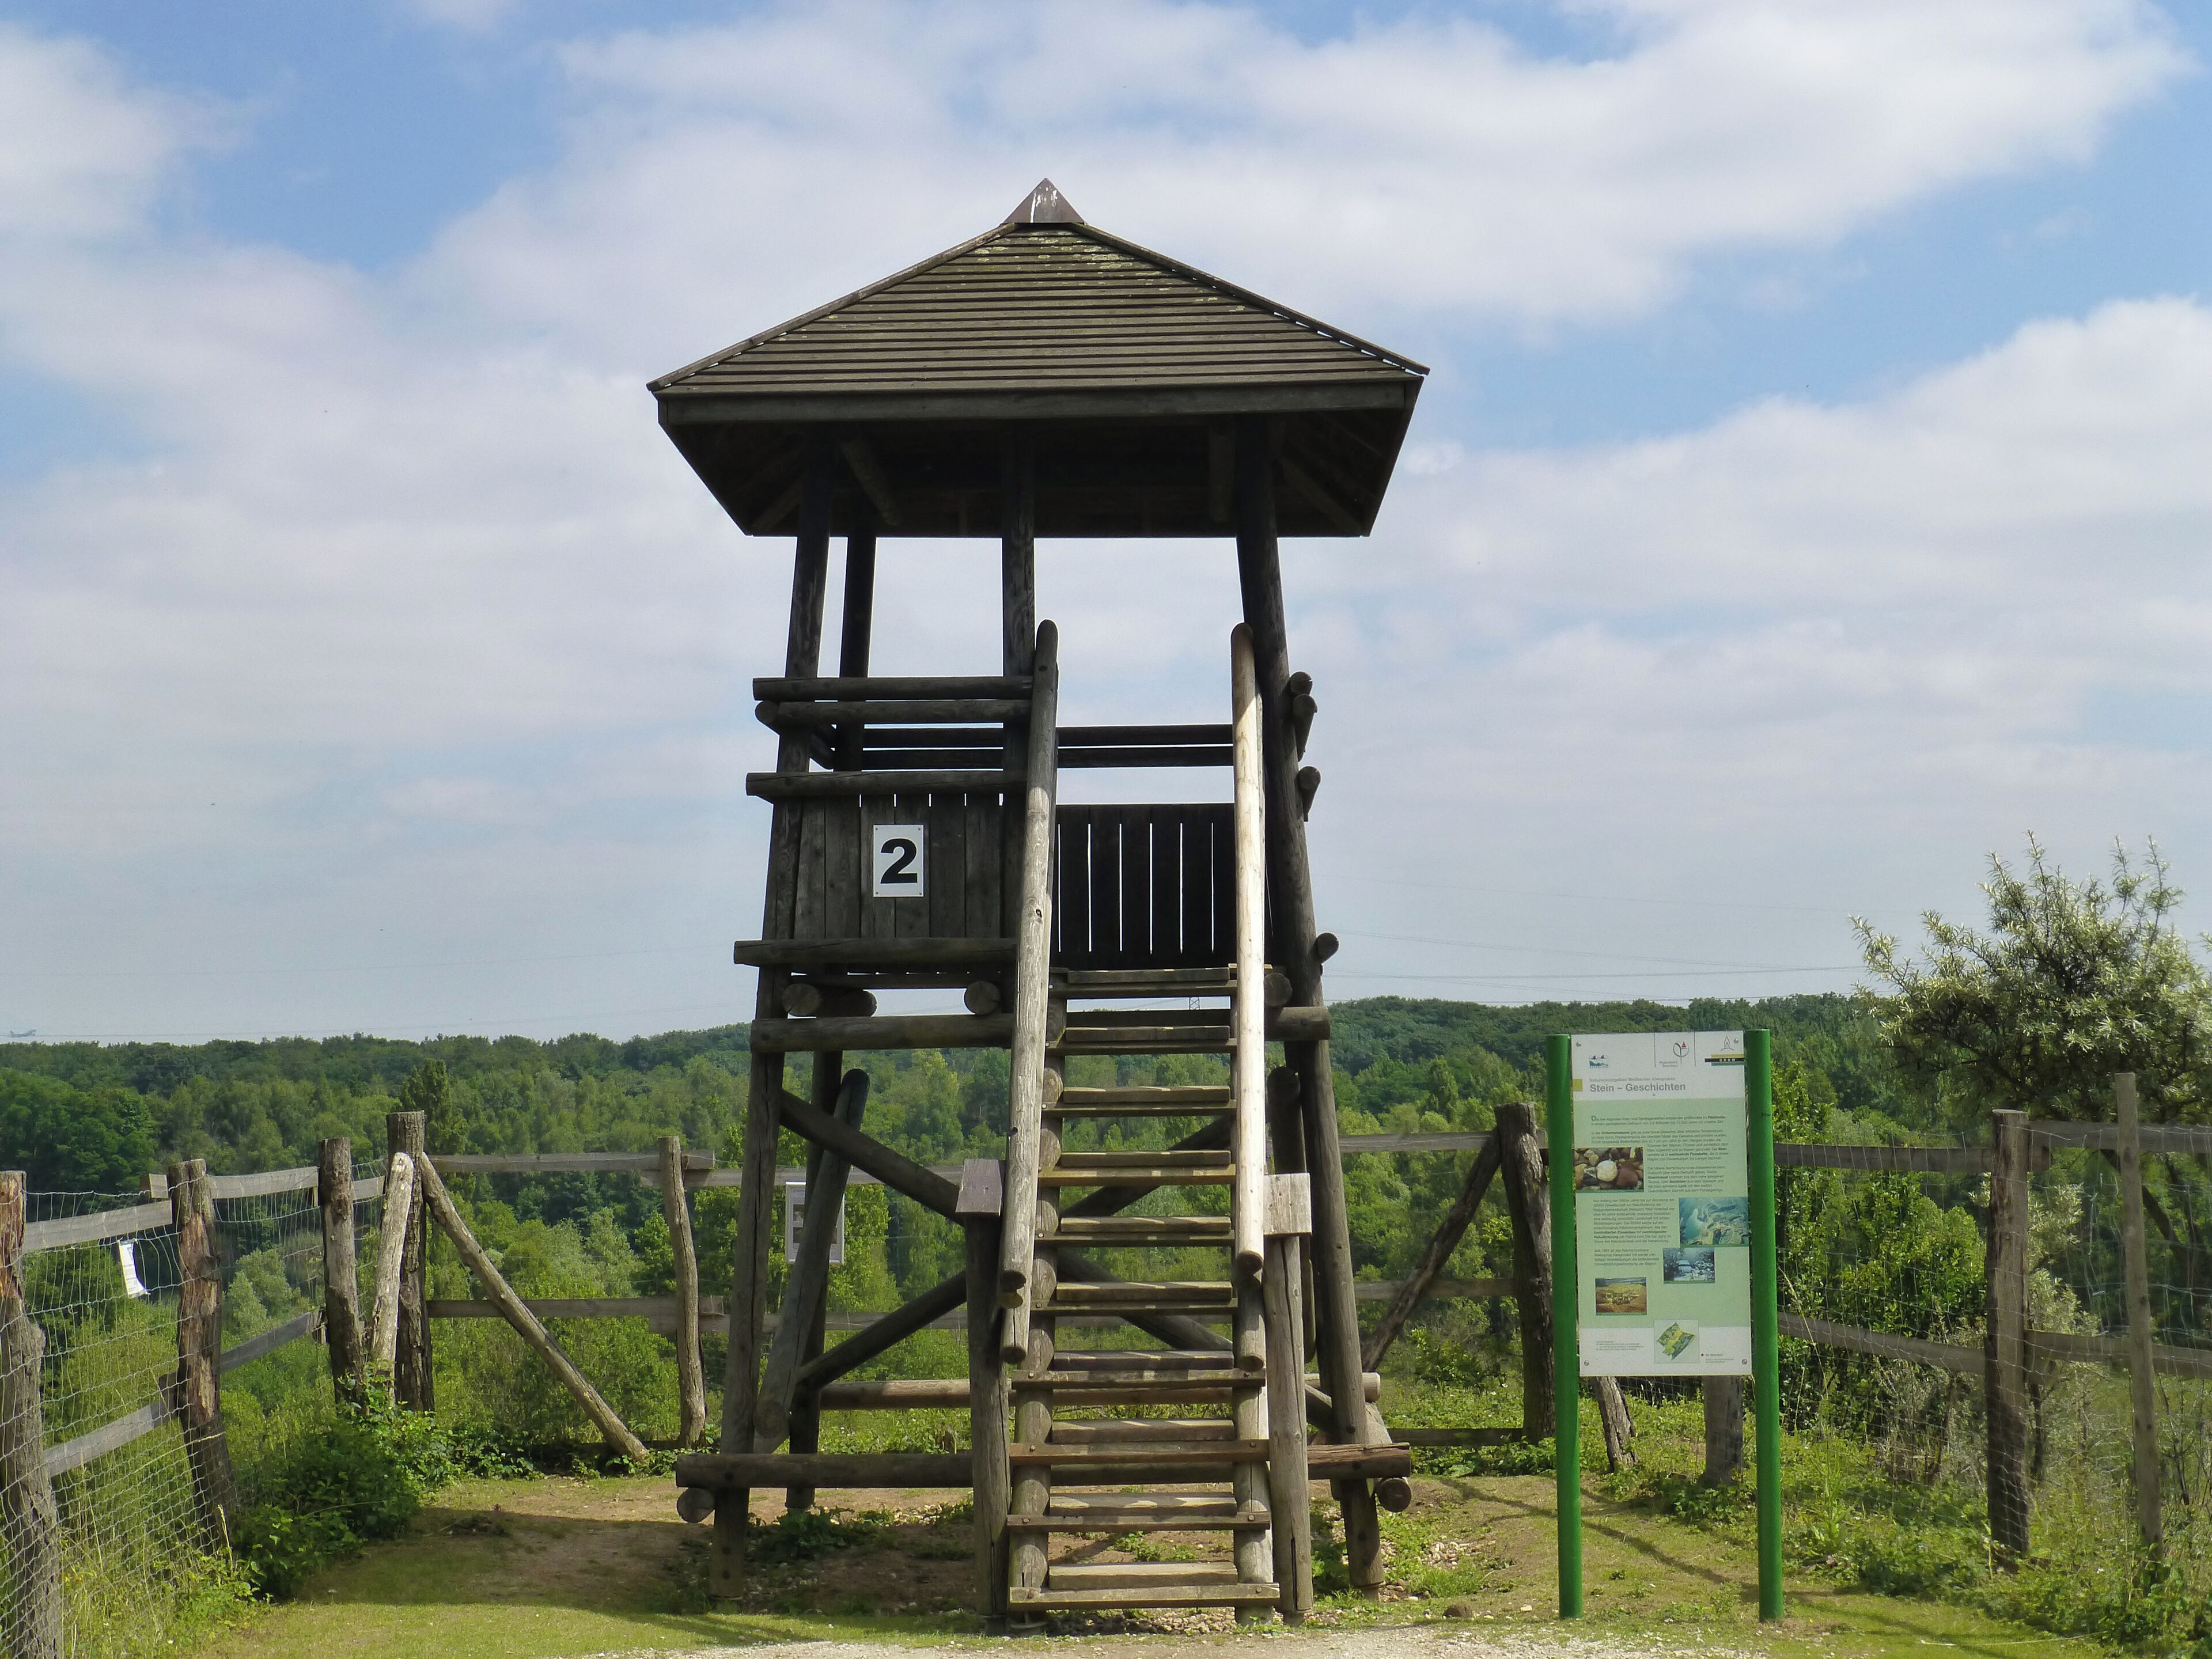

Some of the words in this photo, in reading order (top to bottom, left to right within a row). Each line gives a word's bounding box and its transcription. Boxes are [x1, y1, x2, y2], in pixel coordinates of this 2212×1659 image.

[880, 838, 918, 884] 2
[1590, 1084, 1614, 1092] Stein
[1626, 1083, 1686, 1092] Geschichten
